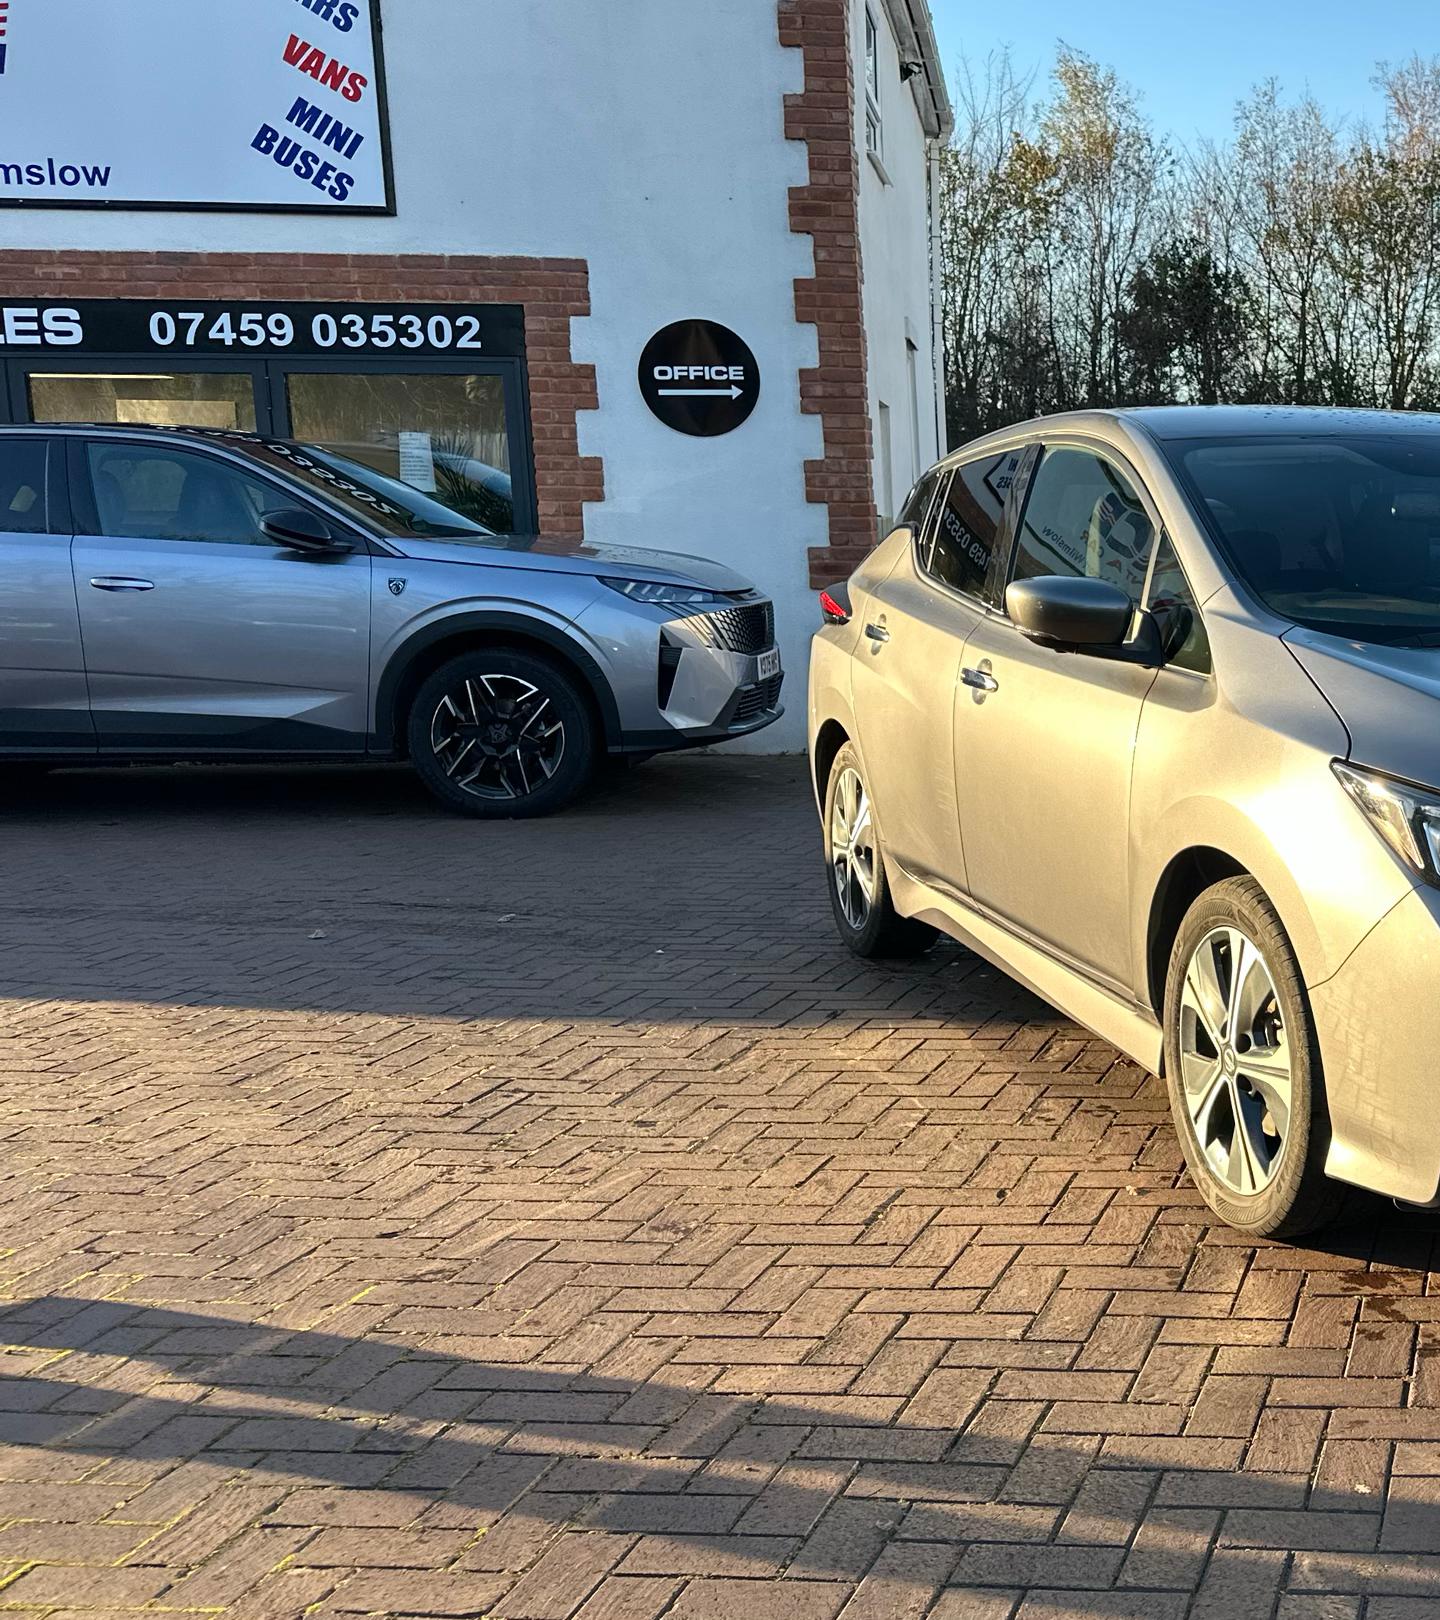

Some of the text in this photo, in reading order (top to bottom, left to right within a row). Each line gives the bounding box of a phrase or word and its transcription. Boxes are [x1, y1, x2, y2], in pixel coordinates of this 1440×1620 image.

[283, 33, 368, 102] VANS
[285, 96, 364, 160] MINI
[250, 123, 355, 201] BUSES
[0, 307, 482, 349] ES 07459 035302
[653, 365, 745, 381] OFFICE
